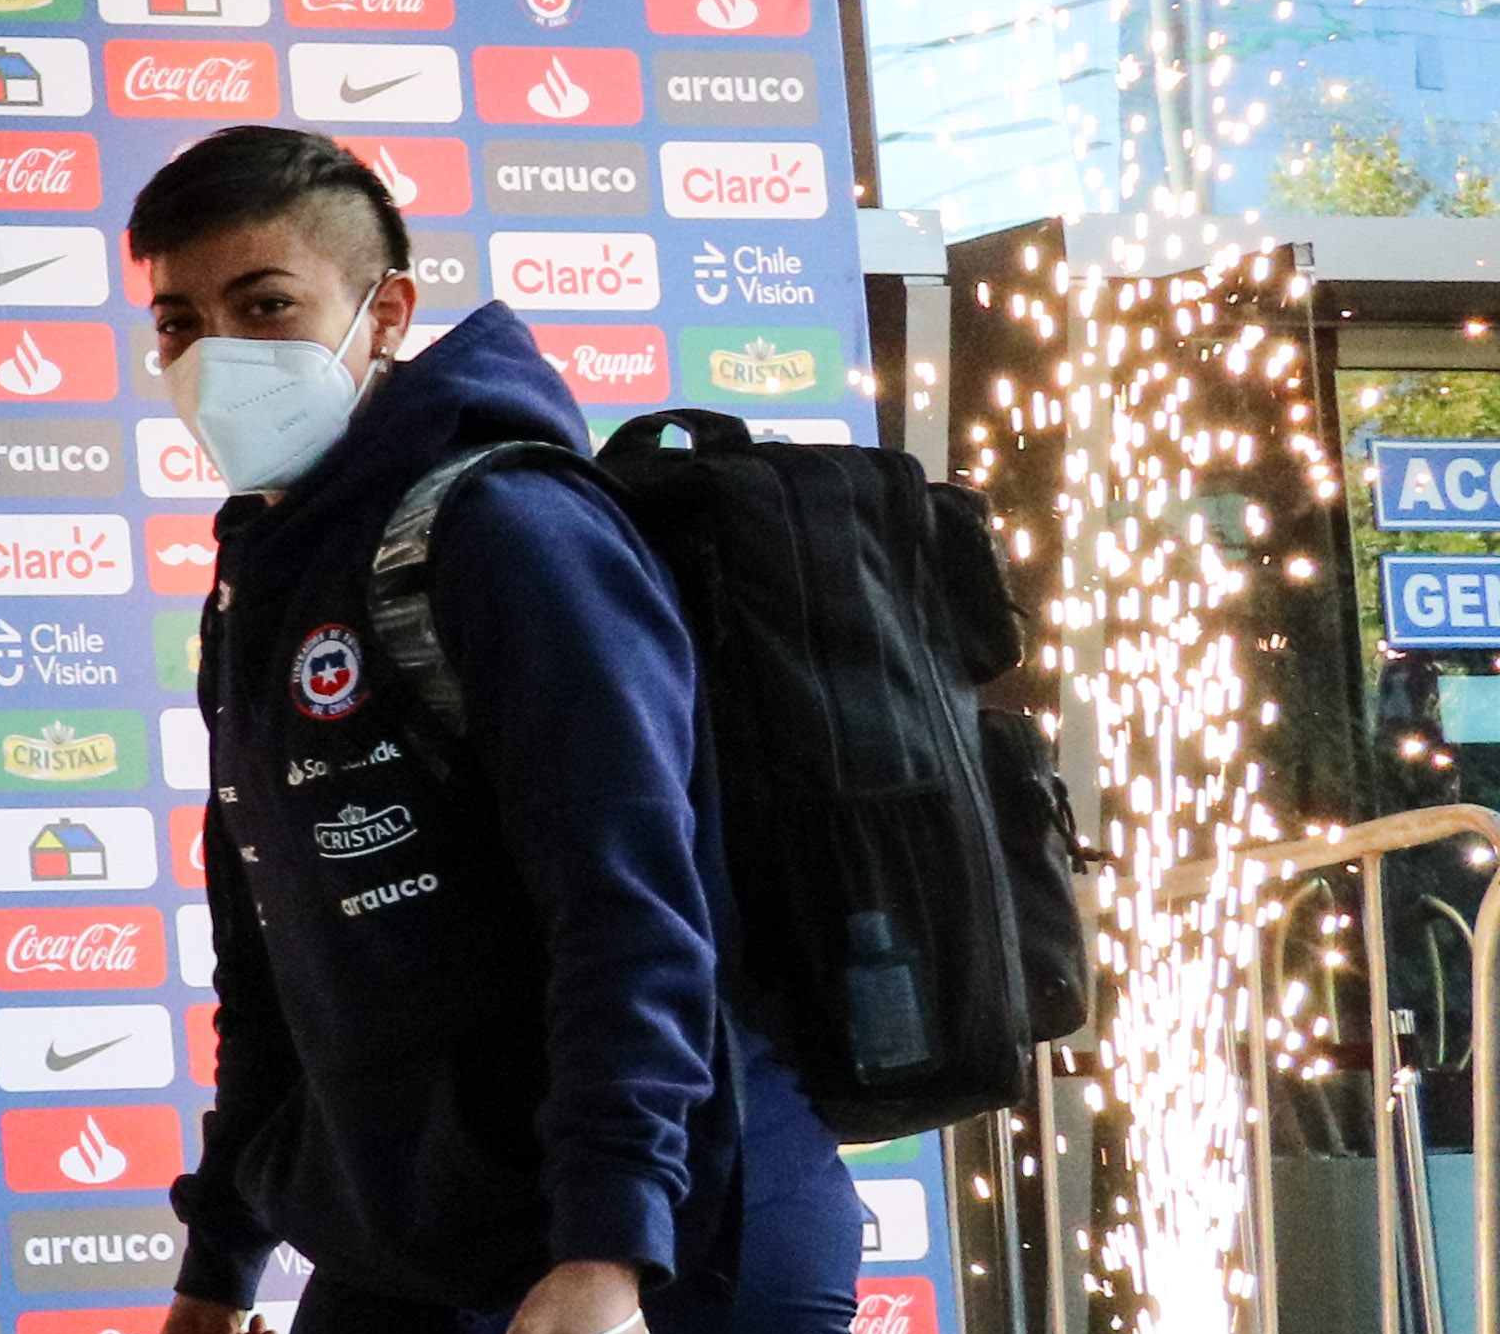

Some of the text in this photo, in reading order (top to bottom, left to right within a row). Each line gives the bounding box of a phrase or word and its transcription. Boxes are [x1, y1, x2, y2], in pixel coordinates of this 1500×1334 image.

[122, 55, 258, 104] Coca-Cola
[666, 74, 804, 104] arauco
[496, 163, 636, 193] arauco
[681, 167, 791, 204] Claro
[511, 258, 623, 294] Claro
[732, 245, 802, 275] Chile
[572, 343, 658, 383] Rappi
[718, 359, 805, 383] CRISTAL
[29, 622, 104, 653] Chile
[12, 744, 106, 770] CRISTAL
[320, 816, 405, 850] CRISTAL
[340, 873, 439, 918] arauco
[3, 922, 144, 973] Coca-Cola
[23, 1231, 175, 1266] arauco
